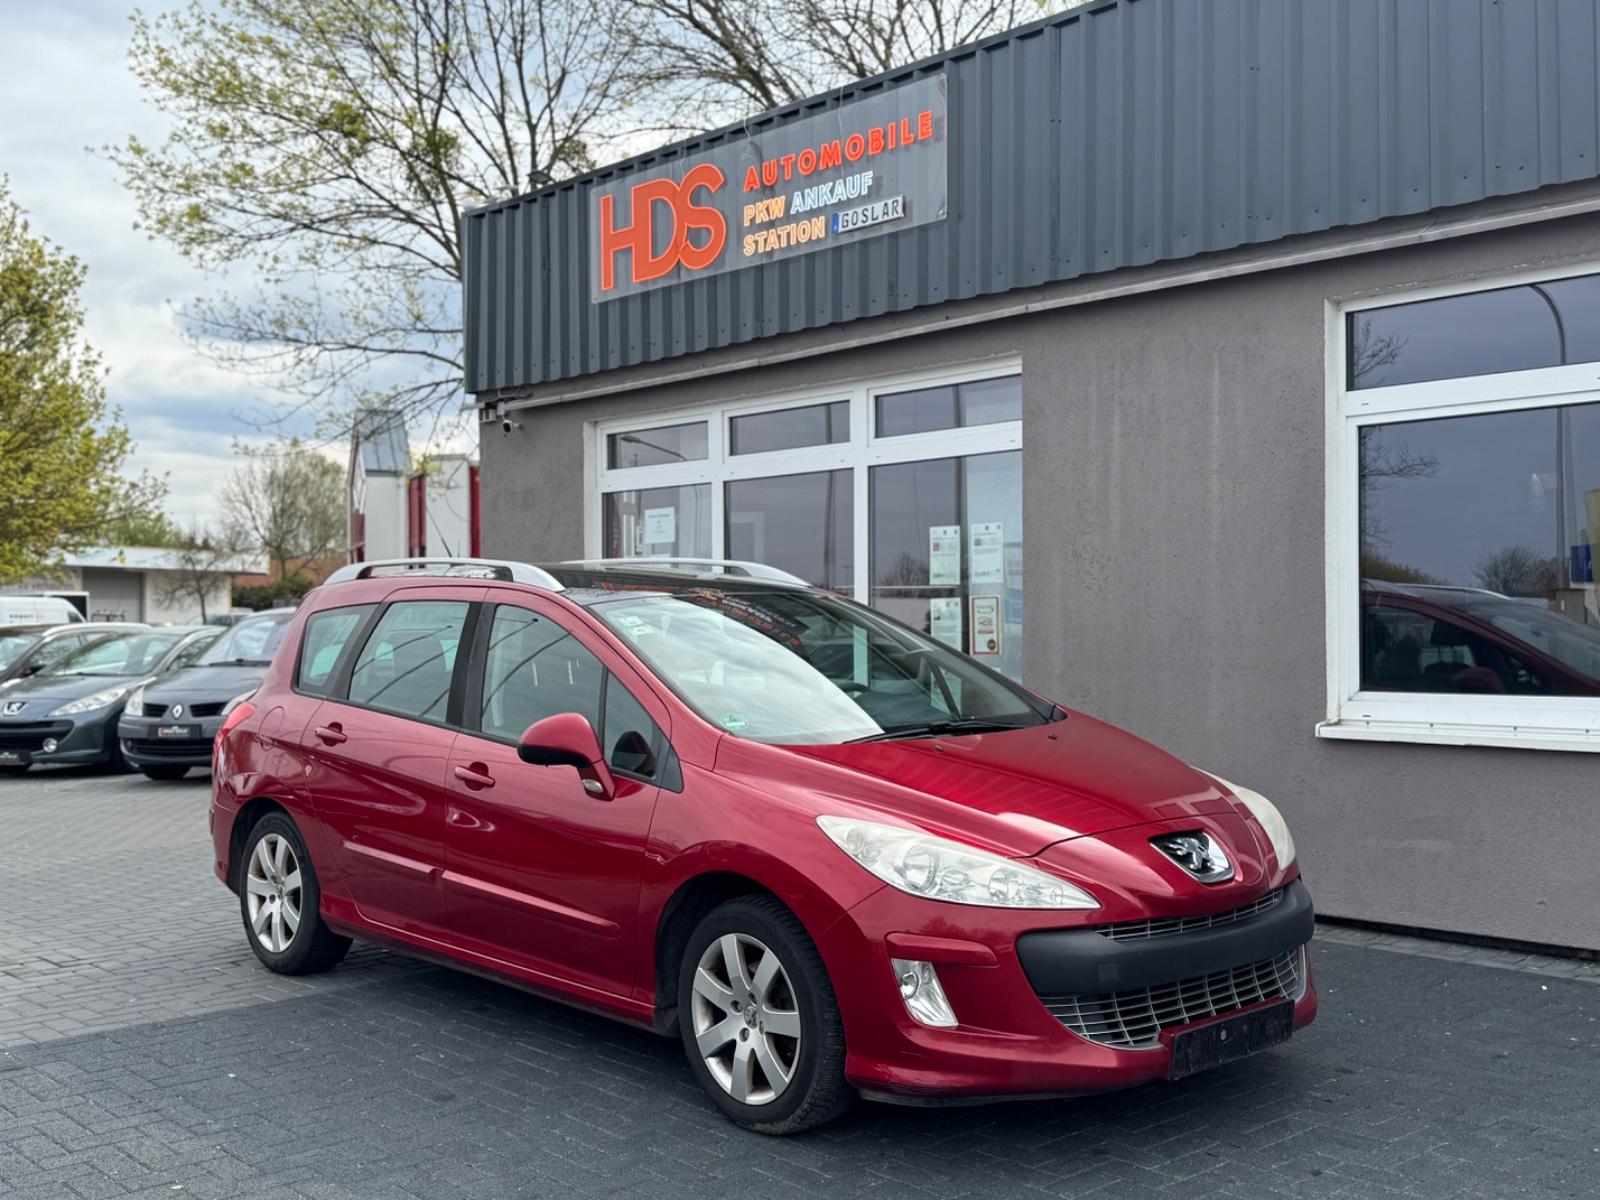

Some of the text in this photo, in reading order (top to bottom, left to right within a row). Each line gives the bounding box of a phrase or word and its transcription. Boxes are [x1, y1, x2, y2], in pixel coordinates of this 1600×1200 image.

[743, 111, 933, 192] AUTOMOBILE
[601, 163, 727, 290] HDS
[743, 171, 873, 226] PKW ANKAUF
[743, 199, 901, 256] STATION GOSLAR
